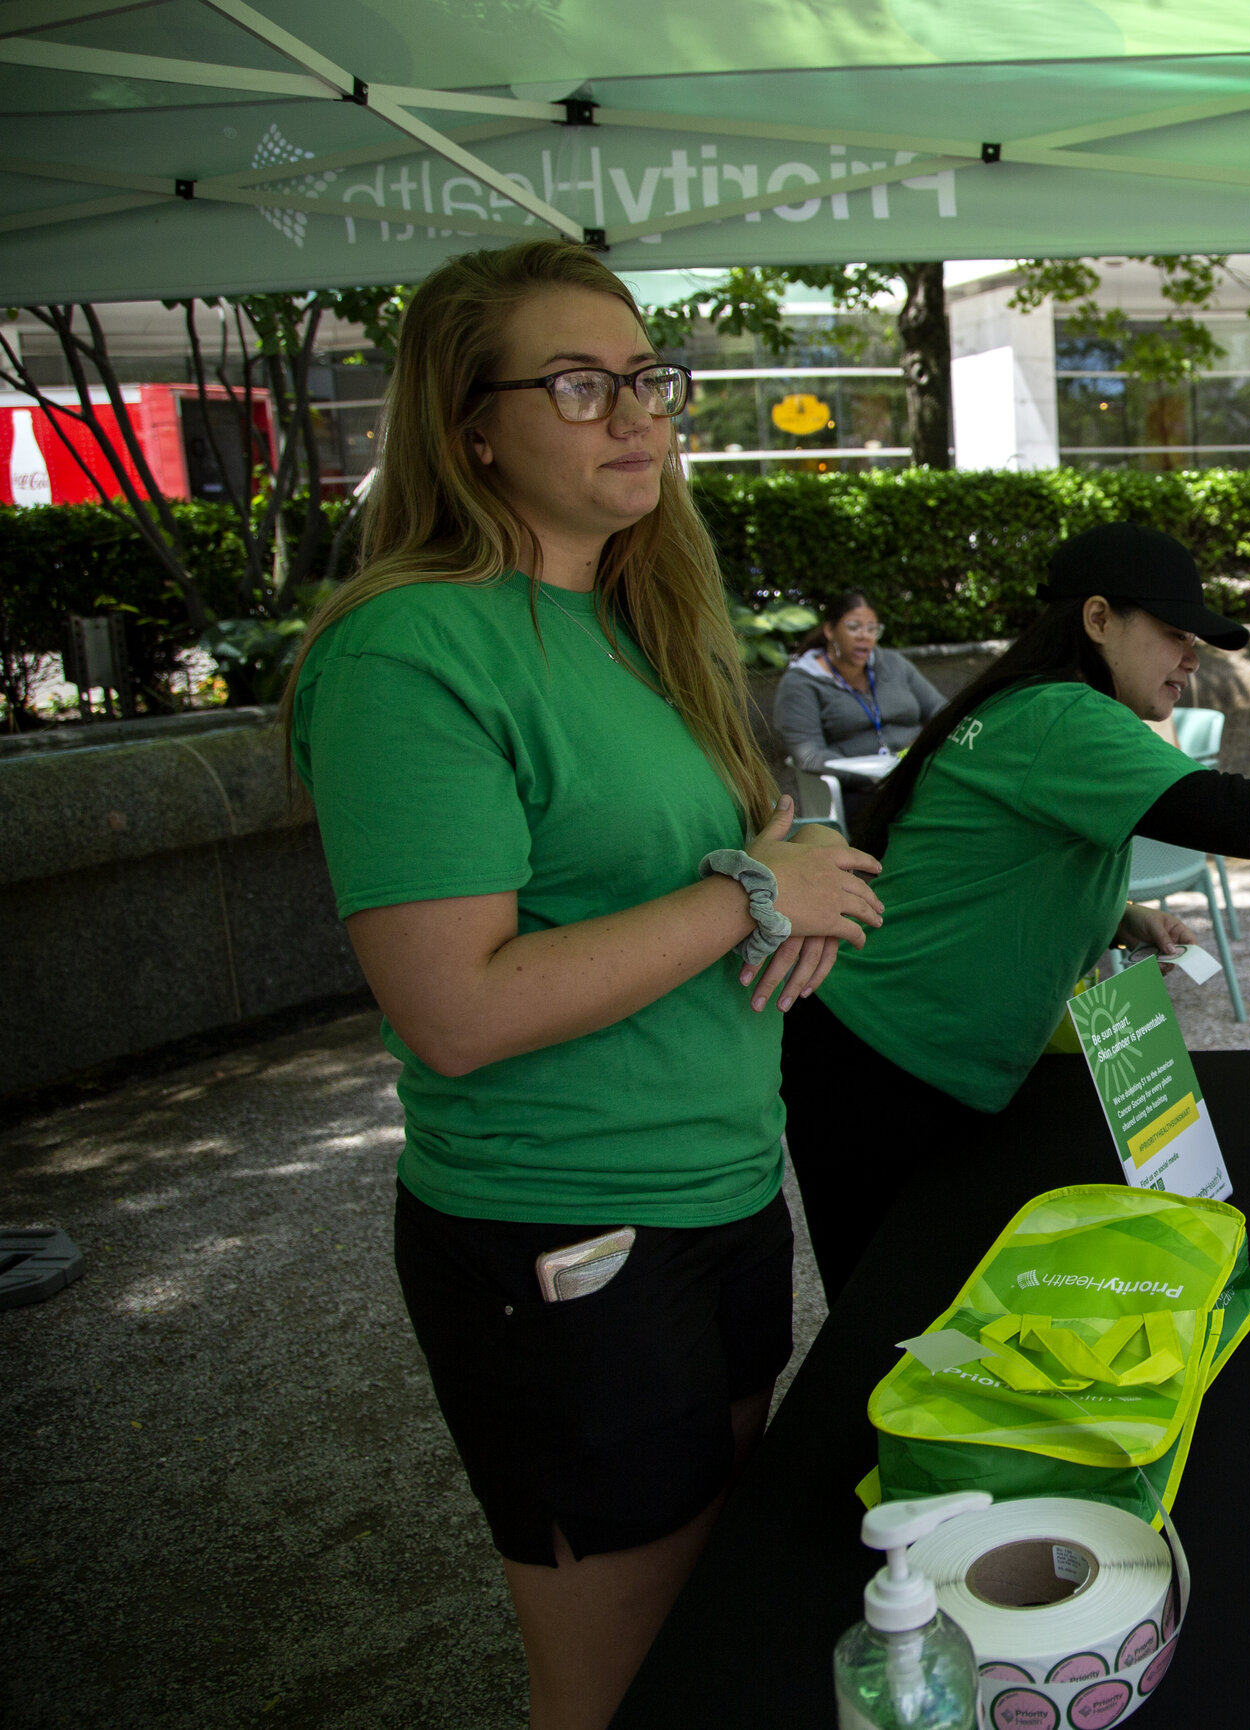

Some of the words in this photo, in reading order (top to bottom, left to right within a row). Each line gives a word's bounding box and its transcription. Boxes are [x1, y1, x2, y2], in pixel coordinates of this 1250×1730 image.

[1092, 1034, 1102, 1046] Be
[1101, 1028, 1112, 1040] sun
[1112, 1016, 1130, 1033] smart.
[1098, 1048, 1112, 1062] Skin
[1112, 1036, 1130, 1054] cancer
[1129, 1032, 1136, 1042] is
[1136, 1012, 1168, 1040] preventable.
[1112, 1093, 1126, 1106] We're
[1124, 1082, 1142, 1097] donating
[1140, 1076, 1147, 1086] $1
[1146, 1074, 1152, 1082] to
[1150, 1070, 1158, 1079] the
[1157, 1058, 1174, 1075] American
[1118, 1104, 1132, 1118] Cancer
[1131, 1094, 1146, 1108] Society
[1152, 1083, 1162, 1094] every
[1162, 1075, 1173, 1088] photo
[1122, 1115, 1136, 1132] shared
[1136, 1110, 1148, 1122] using
[1152, 1094, 1168, 1109] hashtag
[1140, 1177, 1150, 1188] Find
[1148, 1174, 1154, 1182] us
[1152, 1170, 1158, 1178] on
[1158, 1160, 1169, 1174] social
[1168, 1152, 1179, 1165] media
[1042, 1273, 1184, 1299] PriorityHealth
[1070, 1671, 1100, 1683] Priority
[1016, 1710, 1048, 1719] Priority
[1093, 1693, 1124, 1708] Priority
[1016, 1718, 1043, 1726] Health
